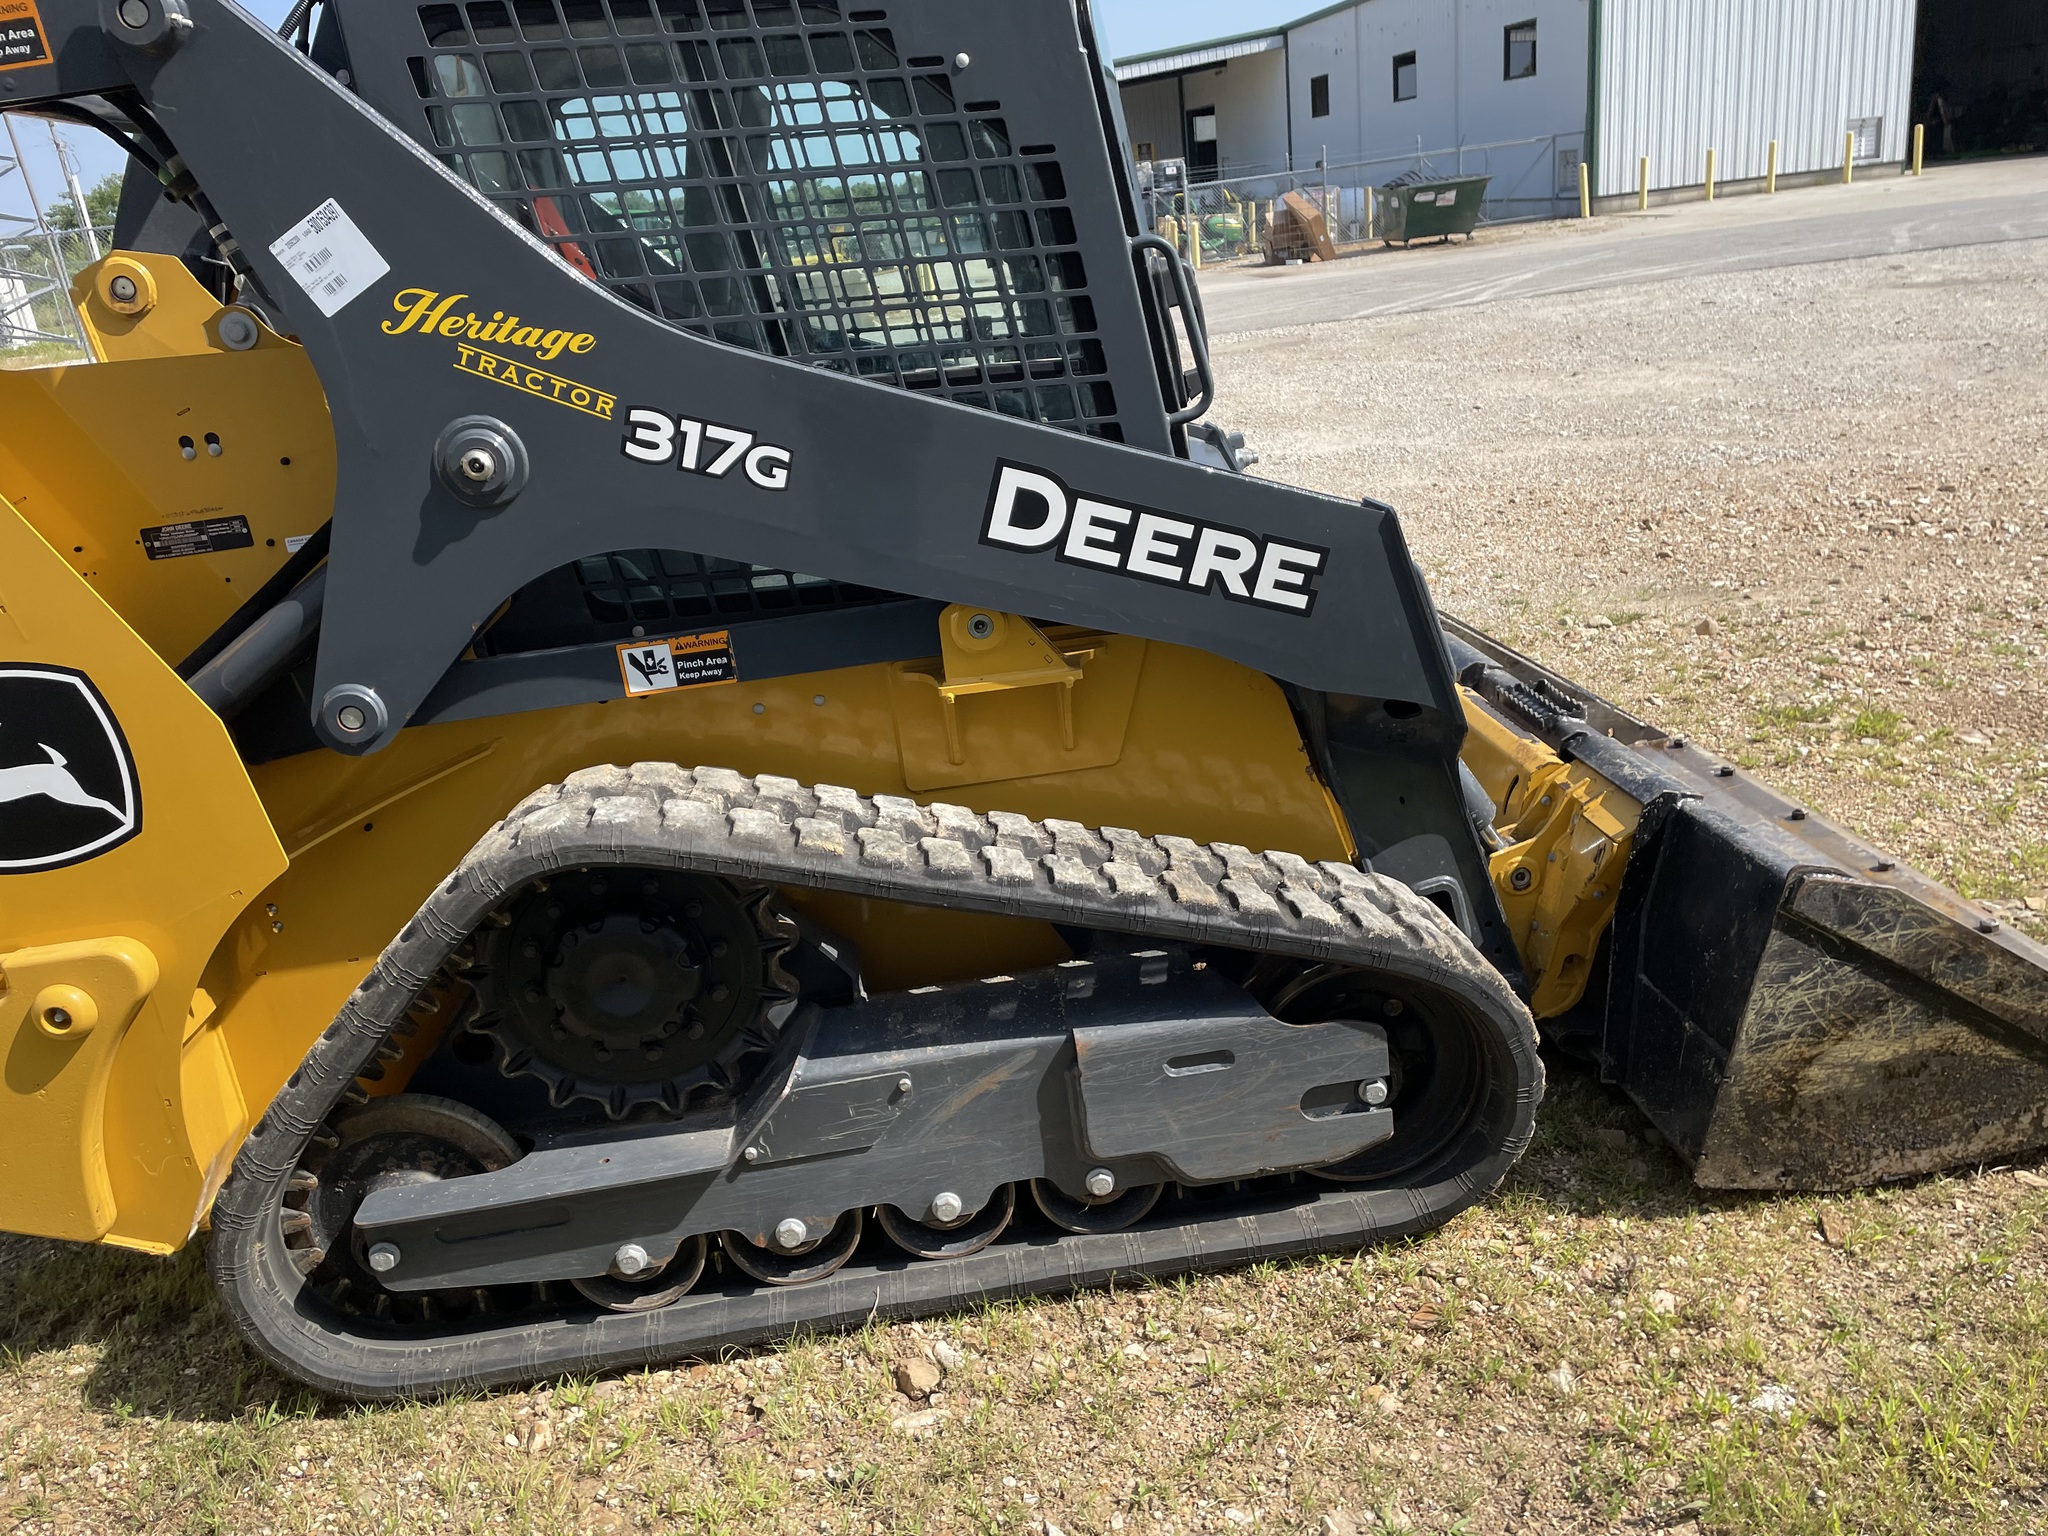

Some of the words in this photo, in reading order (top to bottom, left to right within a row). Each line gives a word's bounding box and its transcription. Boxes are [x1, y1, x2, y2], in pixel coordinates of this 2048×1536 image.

[9, 29, 35, 40] Area
[5, 44, 31, 55] Away
[381, 287, 597, 361] Heritage
[457, 346, 615, 416] TRACTOR
[624, 408, 792, 489] 317G
[986, 465, 1323, 611] DEERE
[683, 638, 727, 649] WARNING
[677, 658, 704, 670] Pinch
[705, 656, 728, 666] Area
[679, 670, 700, 680] Keep
[701, 667, 723, 677] Away
